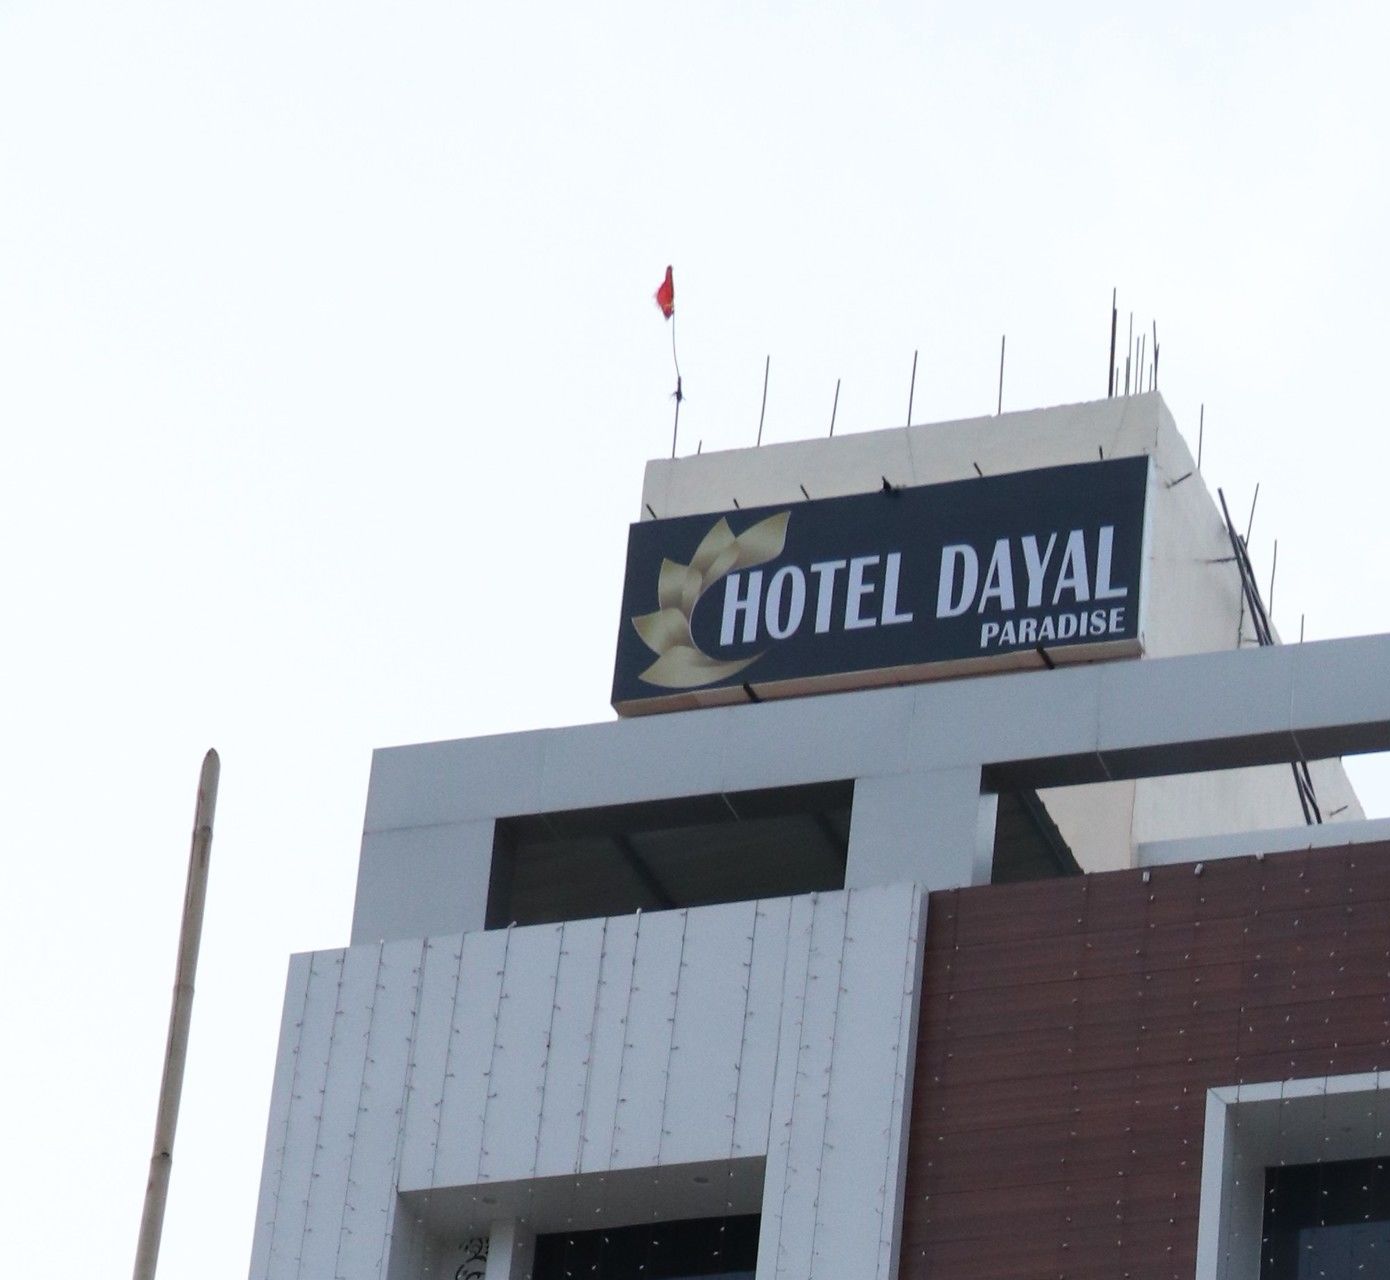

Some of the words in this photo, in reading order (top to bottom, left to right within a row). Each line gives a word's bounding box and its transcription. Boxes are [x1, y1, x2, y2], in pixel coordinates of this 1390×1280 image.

[719, 552, 914, 646] HOTEL
[936, 526, 1128, 619] DAYAL
[980, 608, 1126, 648] PARADISE
